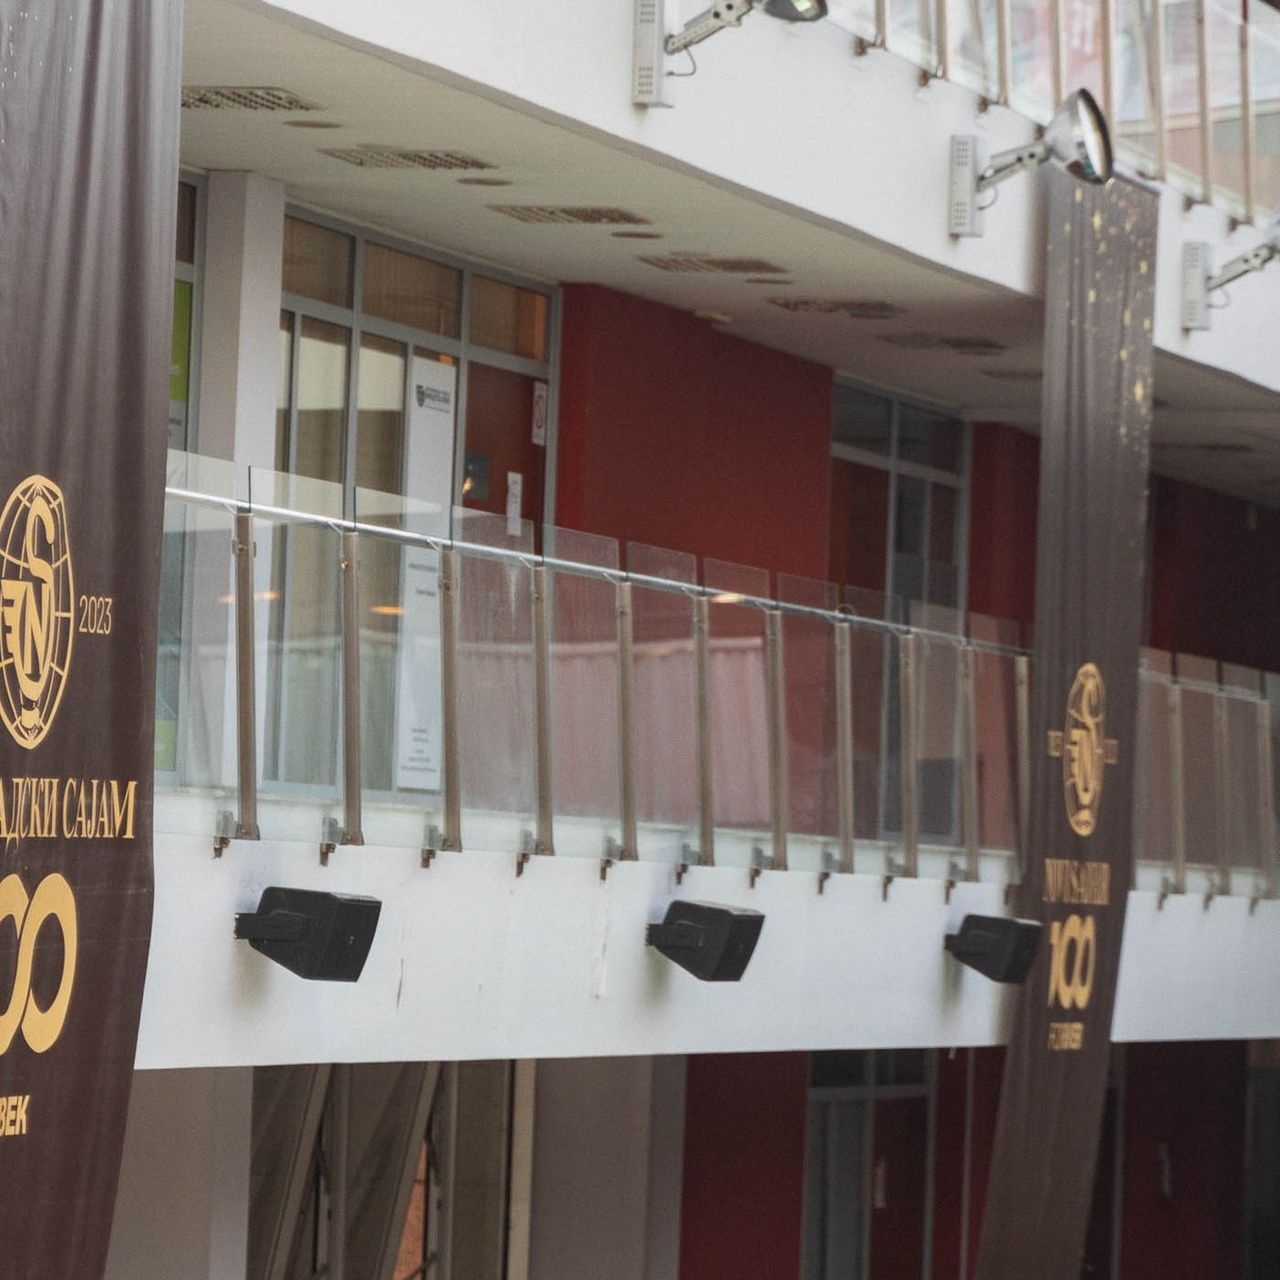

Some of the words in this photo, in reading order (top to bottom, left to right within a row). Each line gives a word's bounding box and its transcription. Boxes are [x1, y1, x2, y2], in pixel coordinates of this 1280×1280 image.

[78, 594, 113, 635] 2023
[62, 777, 138, 839] САЈАМ
[1047, 913, 1096, 1010] 100
